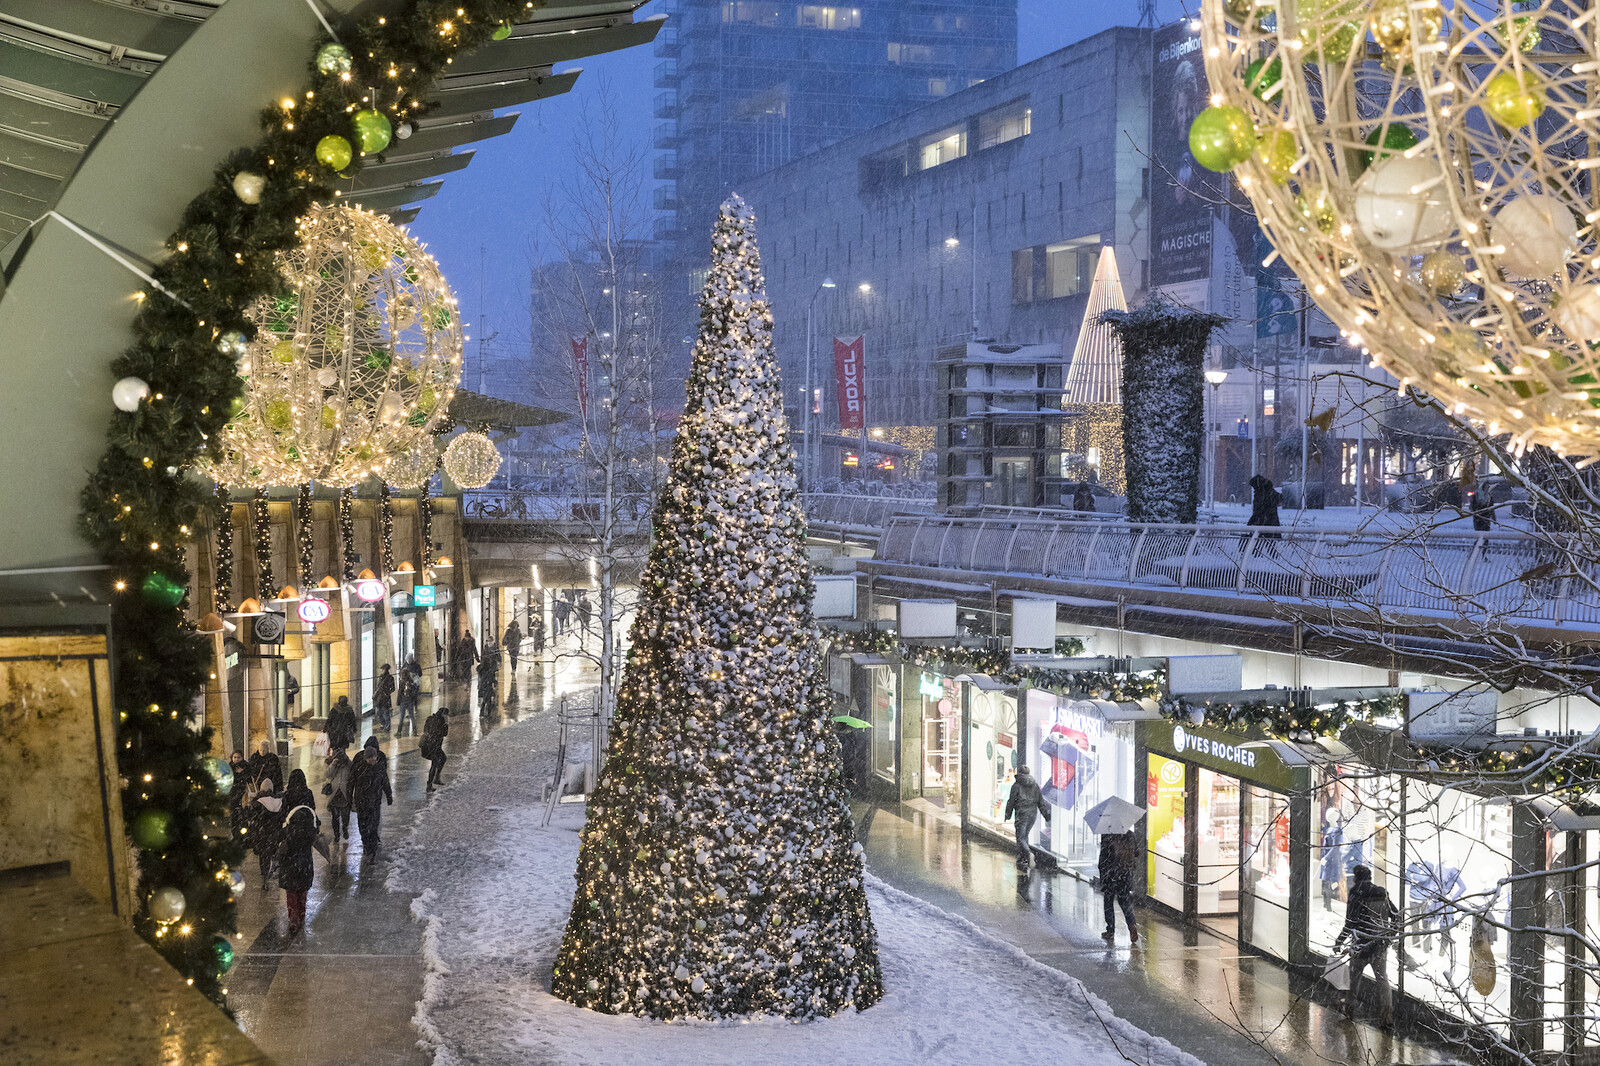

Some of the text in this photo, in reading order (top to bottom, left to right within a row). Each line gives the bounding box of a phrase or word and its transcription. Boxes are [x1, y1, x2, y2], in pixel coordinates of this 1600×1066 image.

[1159, 47, 1169, 62] de
[1161, 231, 1210, 252] MAGISCHE
[303, 606, 323, 616] C&A
[1185, 733, 1255, 767] YVES ROCHER
